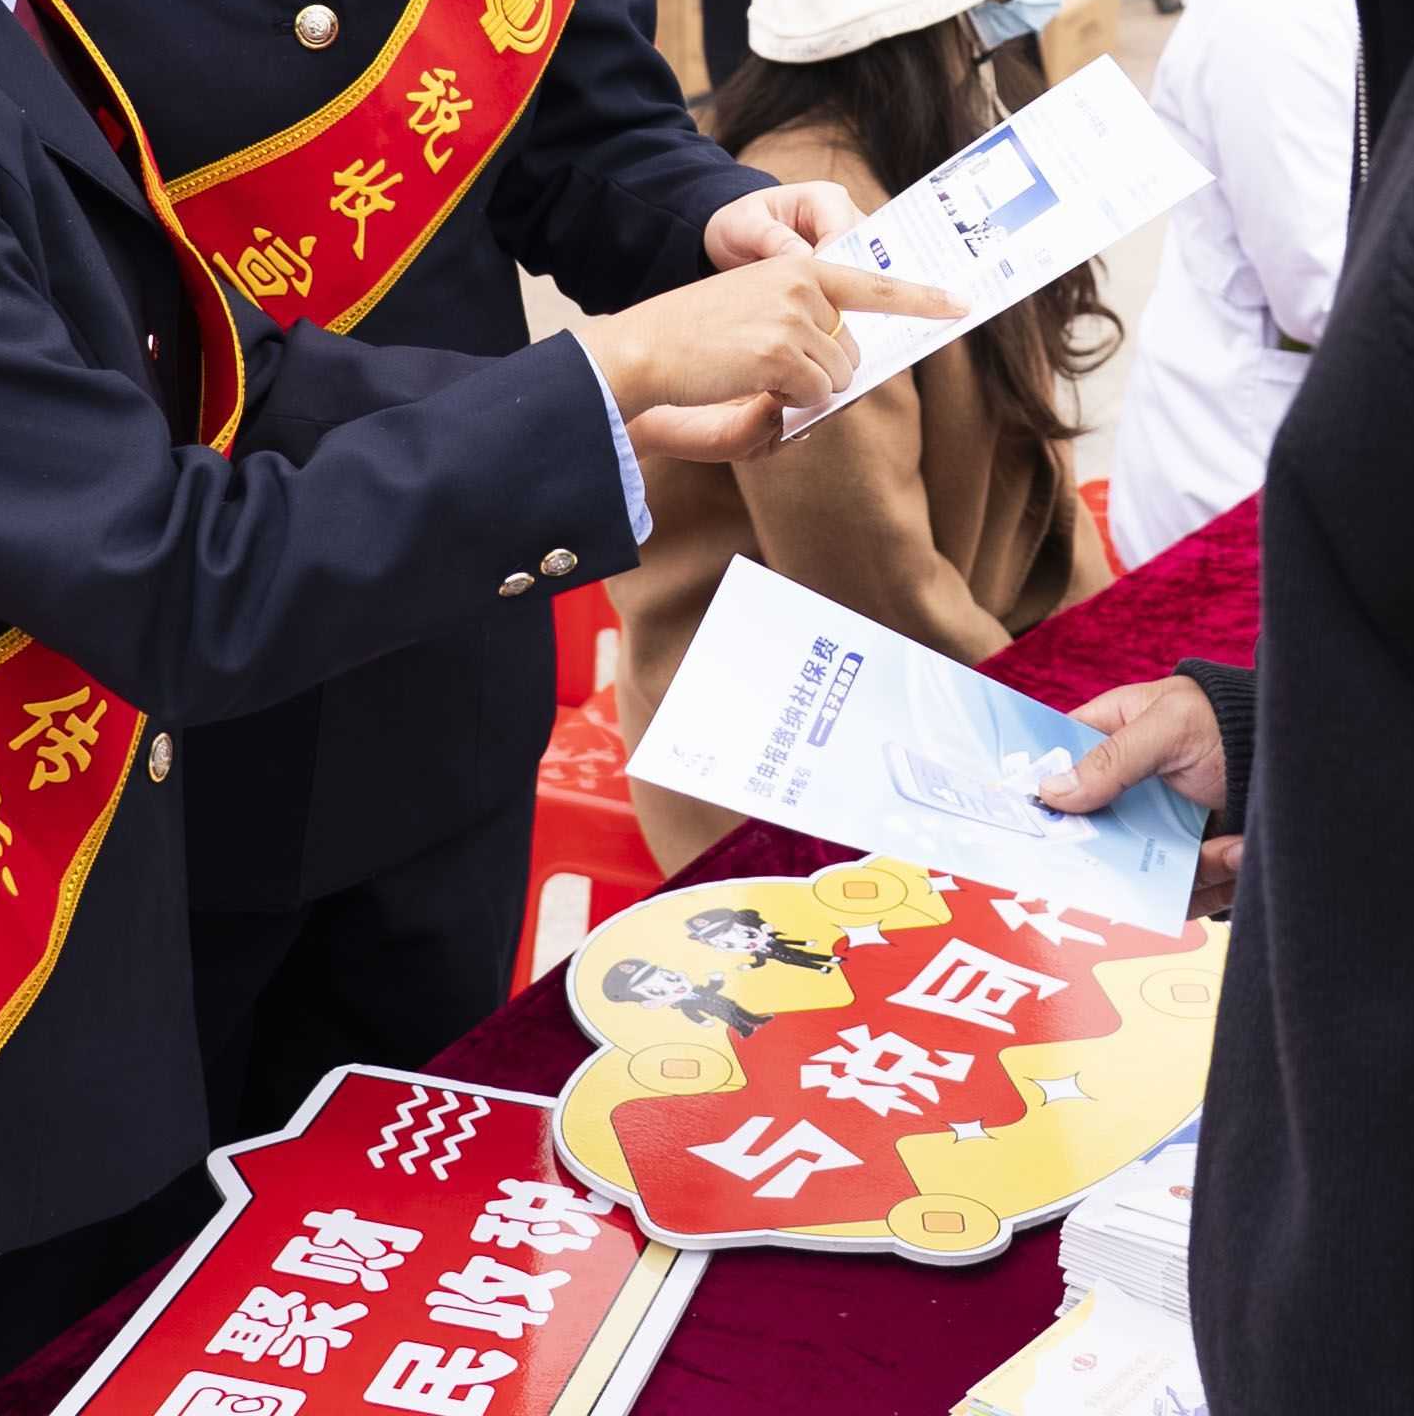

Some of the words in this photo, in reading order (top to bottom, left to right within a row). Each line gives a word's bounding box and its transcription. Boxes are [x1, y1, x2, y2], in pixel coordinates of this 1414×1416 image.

[213, 67, 474, 310] 税收宣
[363, 1178, 615, 1416] 民收税
